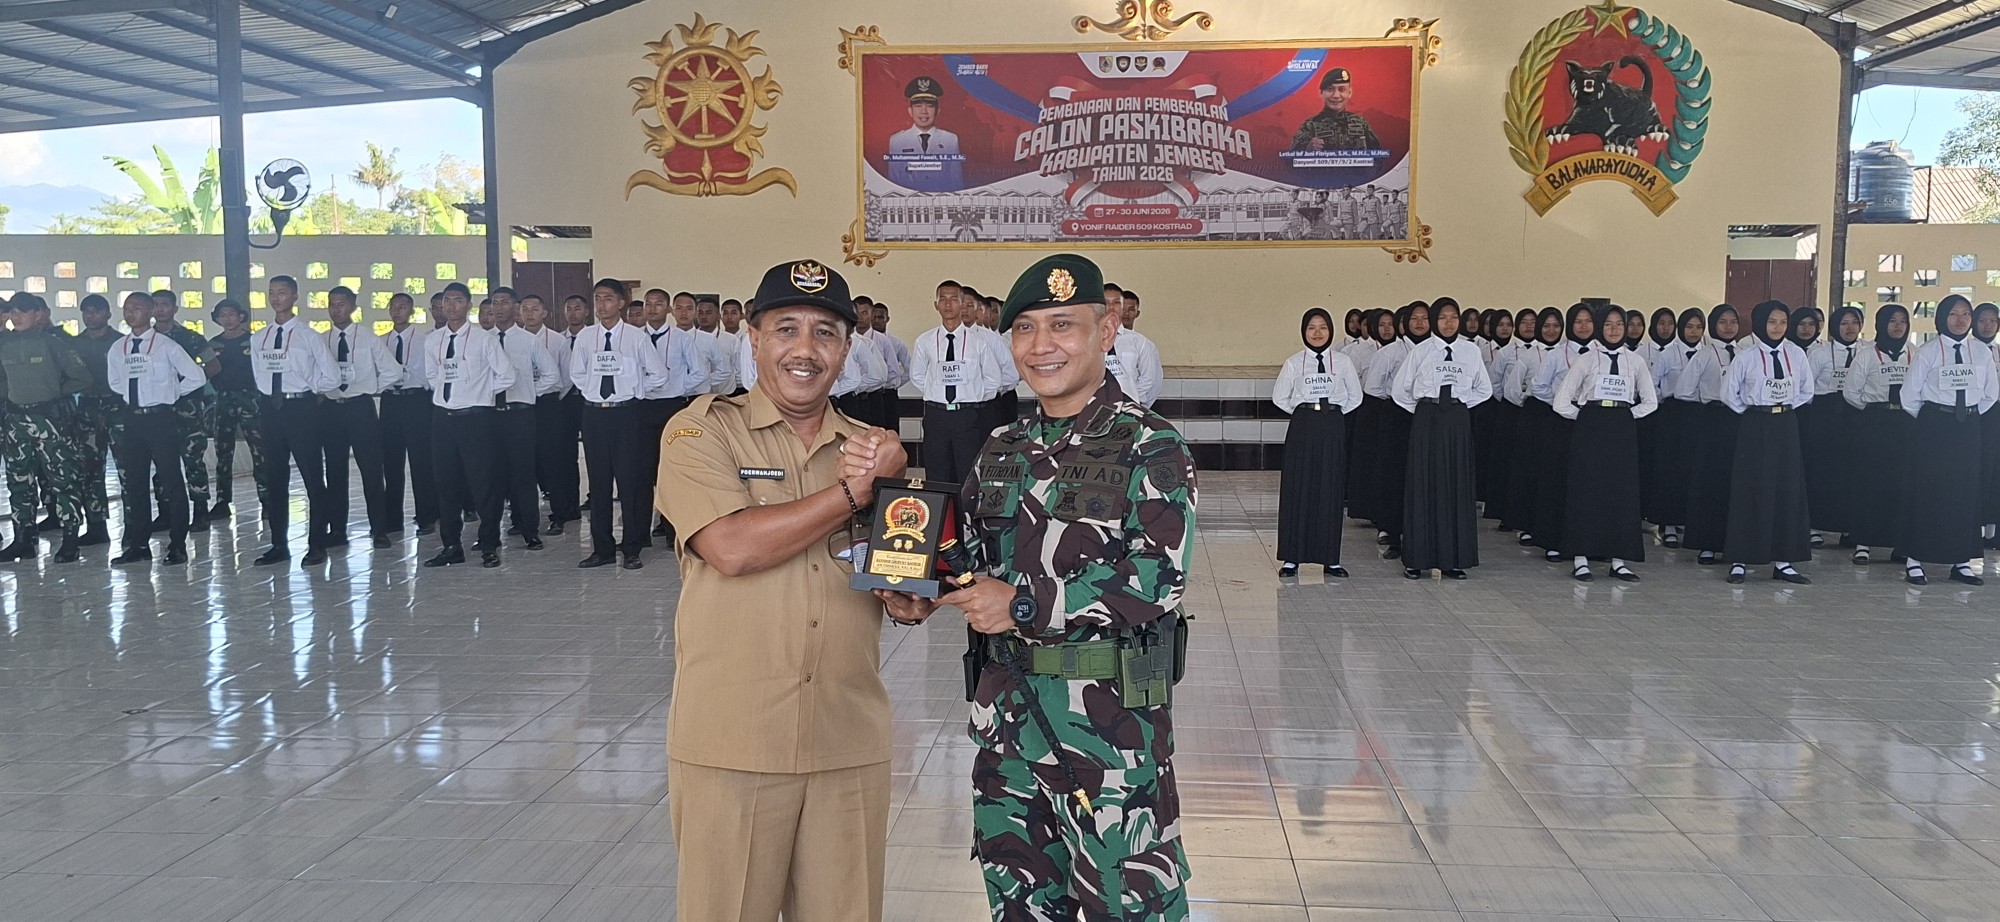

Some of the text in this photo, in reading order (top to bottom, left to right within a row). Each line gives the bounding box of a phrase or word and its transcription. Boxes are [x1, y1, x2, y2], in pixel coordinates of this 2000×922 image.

[1038, 96, 1229, 123] PEMBINAAN DAN PEMBEKALAN
[1014, 113, 1252, 161] CALON PASKIBRAKA
[1038, 143, 1226, 174] KABUPATEN JEMBER
[1092, 166, 1174, 183] TAHUN 2026
[1545, 158, 1658, 191] BALAWARAYUDHA
[1105, 208, 1116, 216] 27
[1120, 208, 1132, 216] 30
[1132, 208, 1150, 216] JUNI
[1150, 208, 1171, 216] 2026
[1136, 223, 1152, 231] 509
[1153, 223, 1193, 231] KOSTRAD
[942, 365, 961, 373] RAFI
[1435, 366, 1463, 374] SALSA
[1942, 369, 1974, 377] SALWA
[1305, 376, 1333, 385] GHINA
[1603, 378, 1626, 386] FERA
[1766, 380, 1792, 390] RAYYA
[1061, 465, 1124, 486] TNI AD
